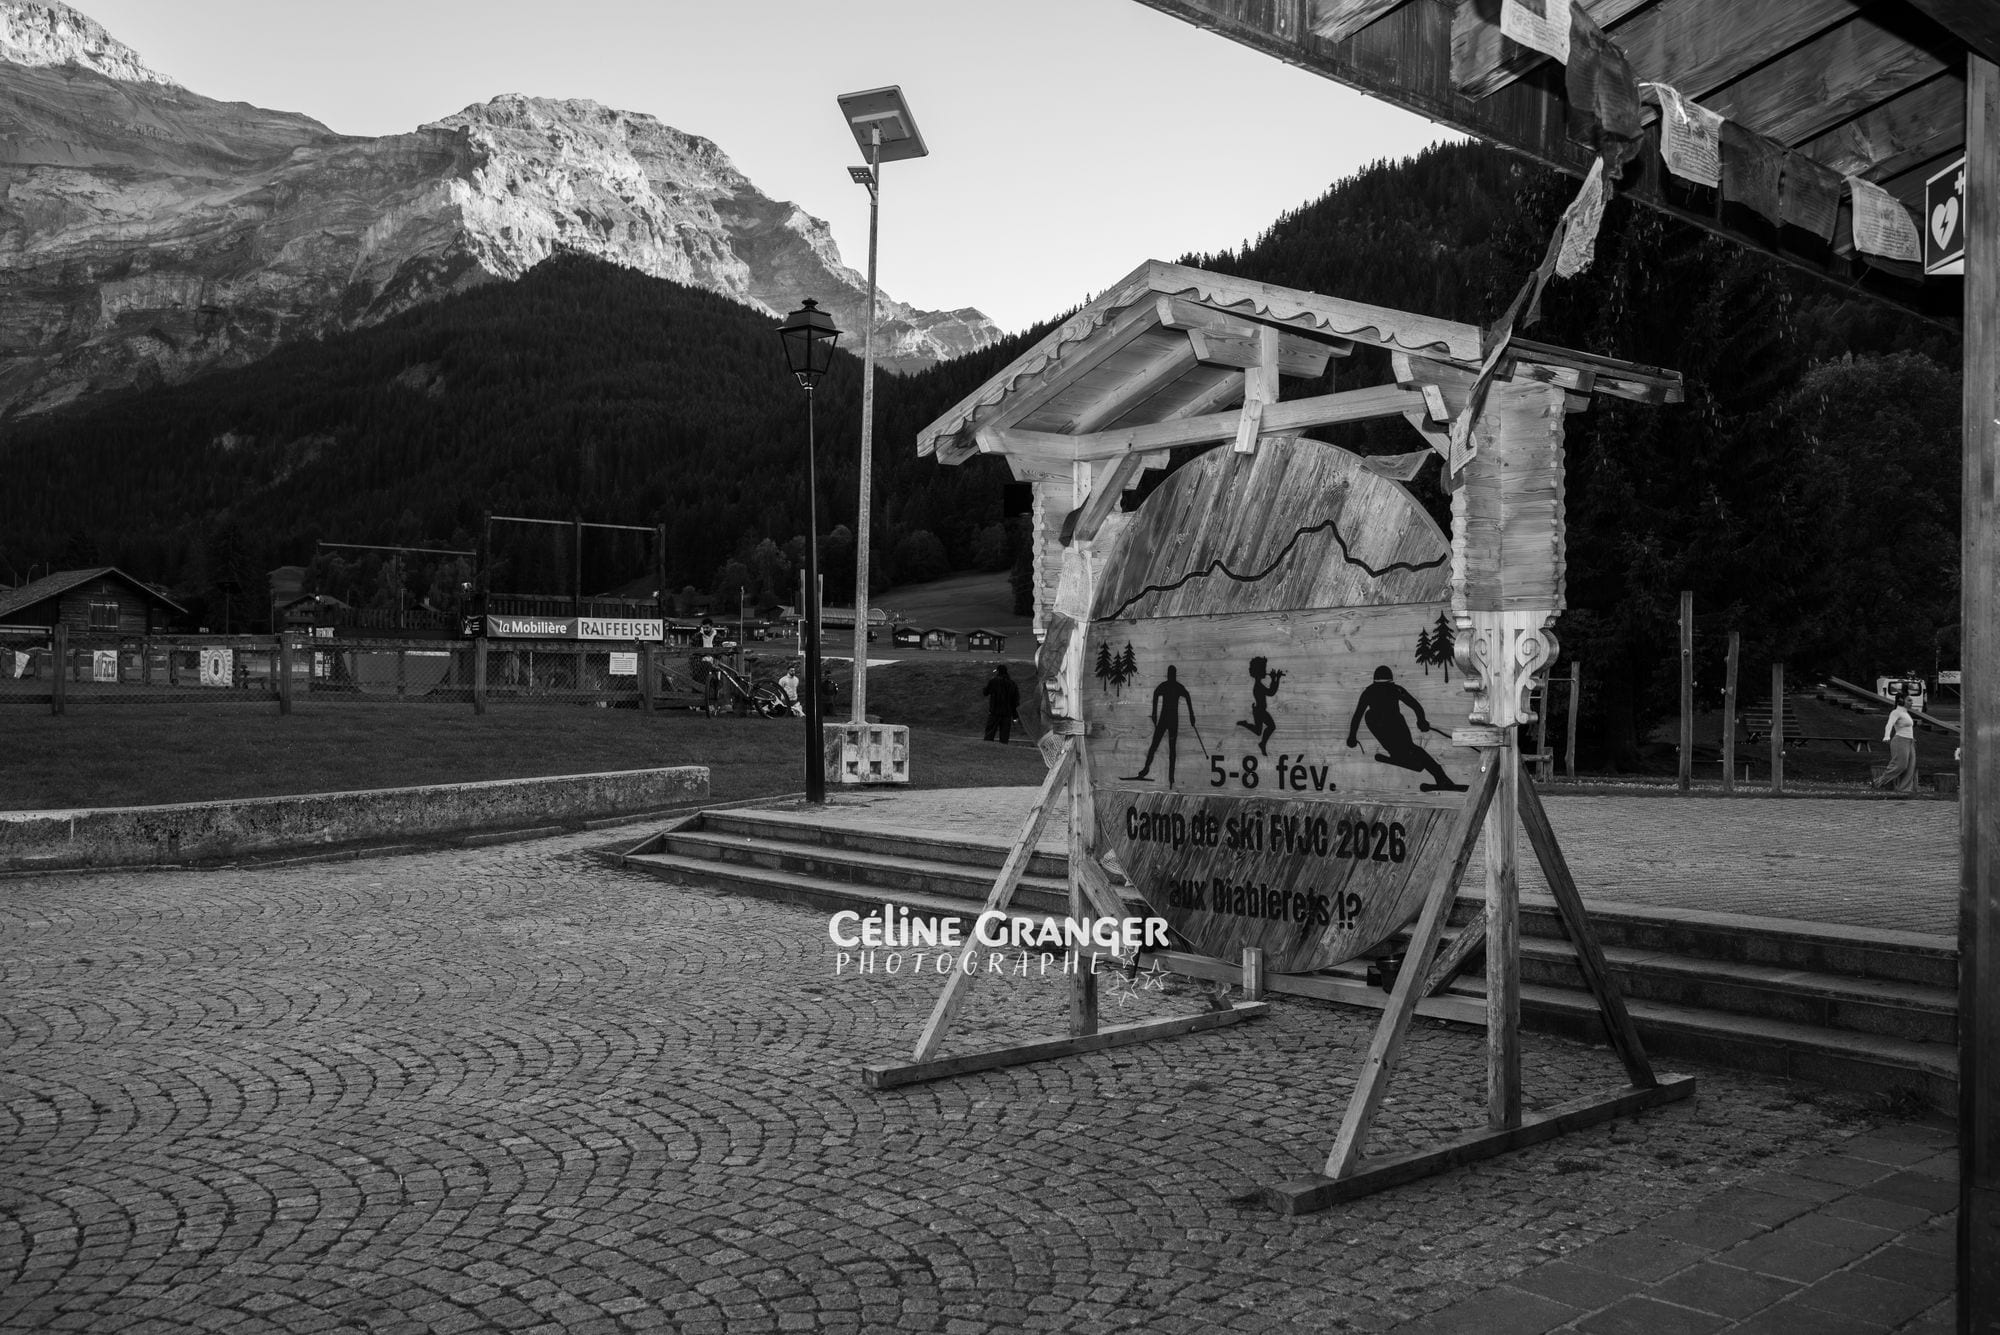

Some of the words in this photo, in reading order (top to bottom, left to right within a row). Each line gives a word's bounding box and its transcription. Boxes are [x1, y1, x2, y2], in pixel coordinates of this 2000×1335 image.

[498, 620, 511, 633] la
[511, 620, 567, 634] Mobilière
[580, 621, 661, 637] RAIFFEISEN
[1210, 754, 1259, 788] 5-8
[1275, 754, 1337, 792] fév.
[1126, 806, 1186, 851] Camp
[1191, 810, 1219, 848] de
[1225, 810, 1263, 851] ski
[1270, 814, 1329, 858] FVJC
[1335, 819, 1407, 864] 2026
[1168, 879, 1207, 912] aux
[1212, 877, 1331, 927] Diablerets
